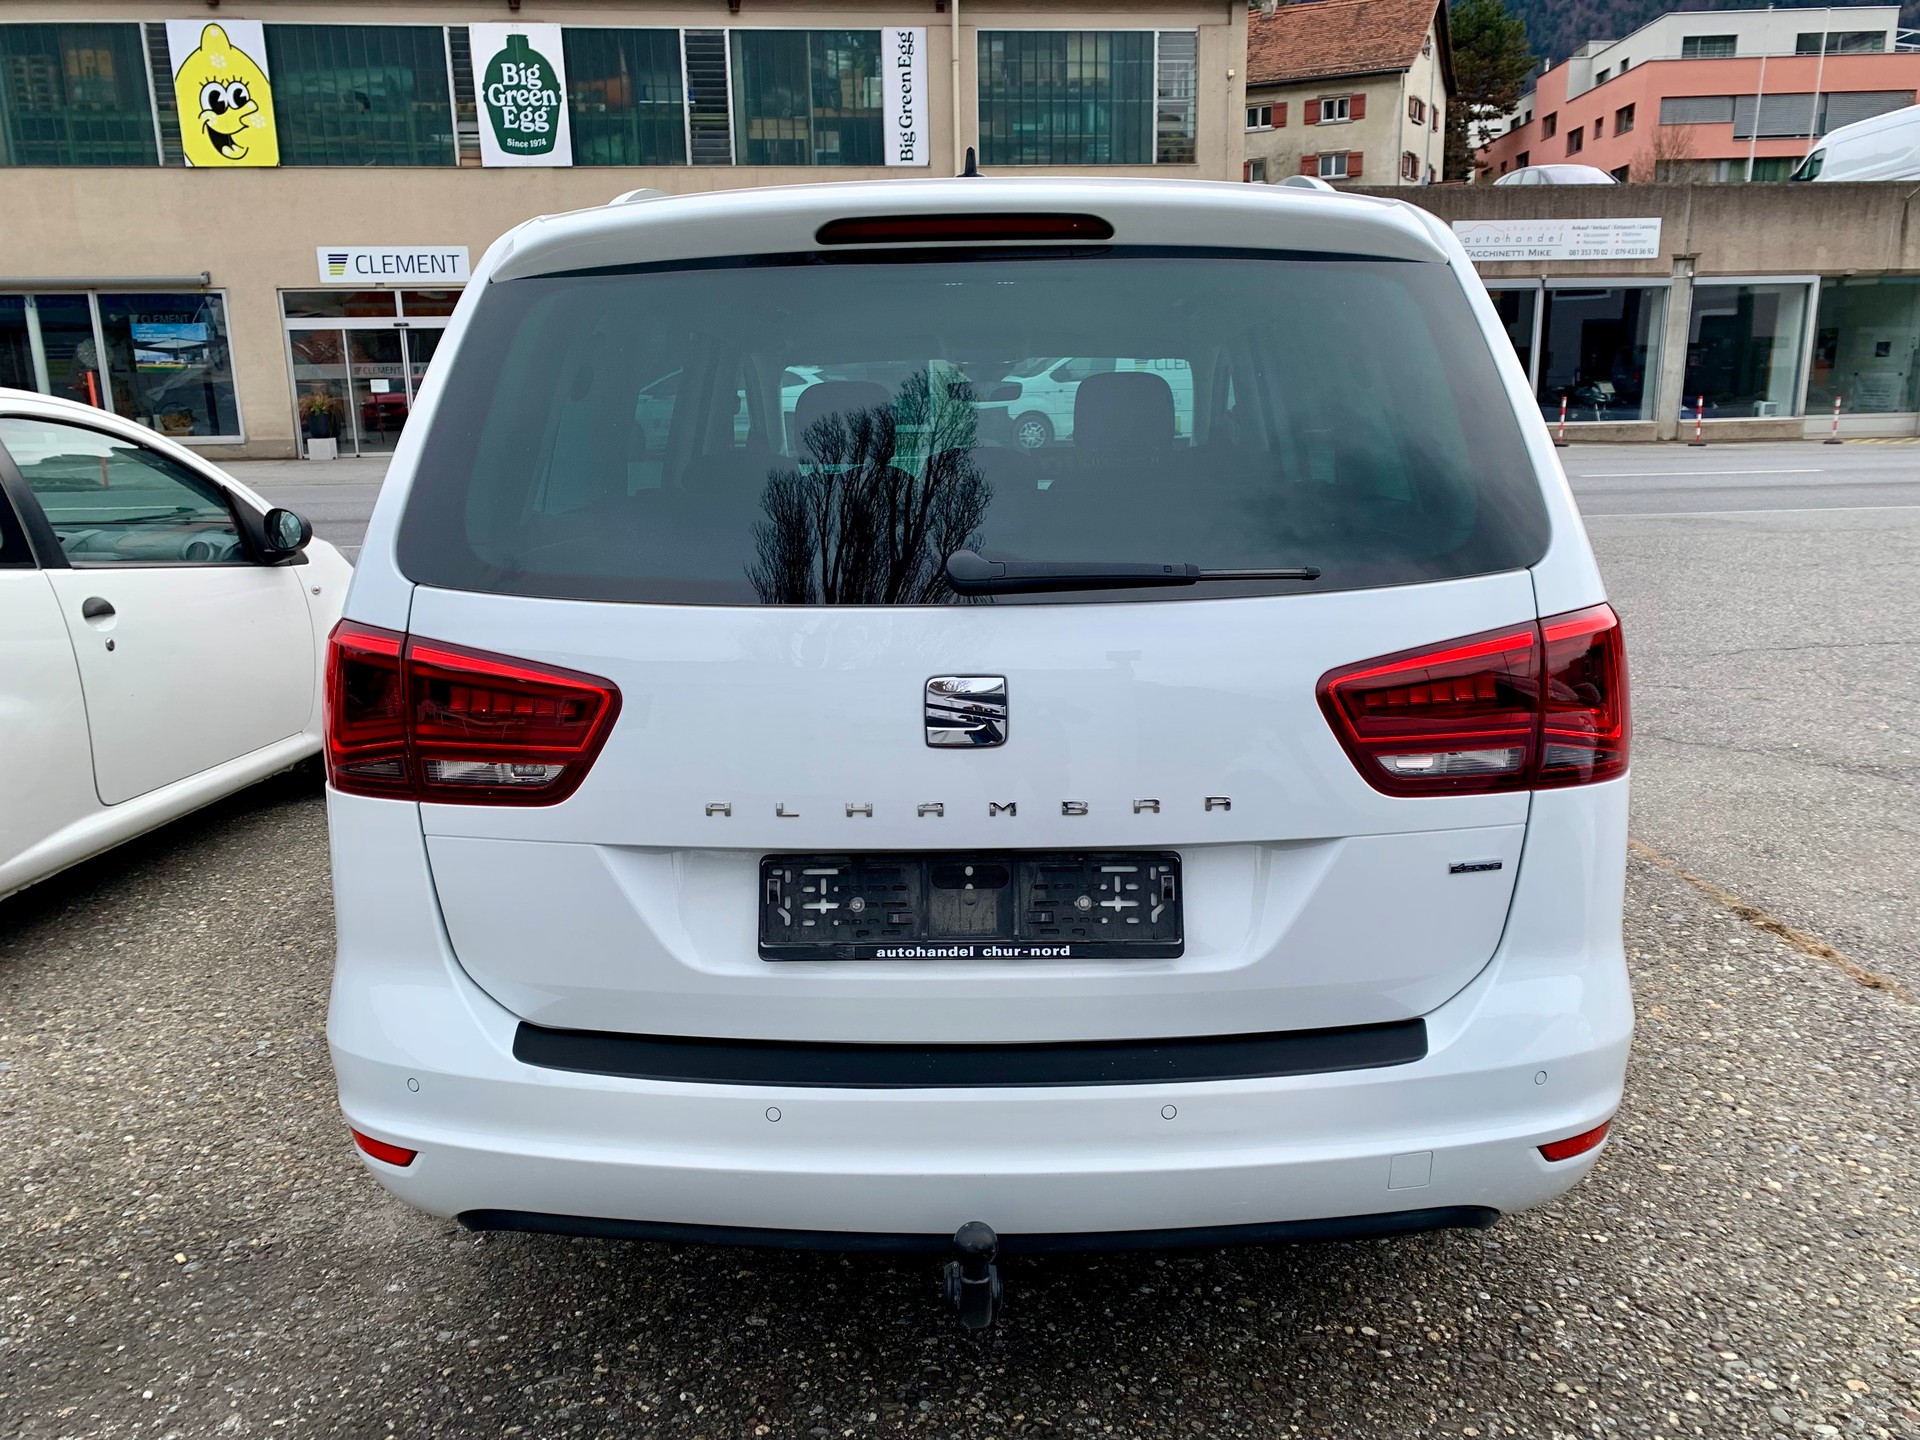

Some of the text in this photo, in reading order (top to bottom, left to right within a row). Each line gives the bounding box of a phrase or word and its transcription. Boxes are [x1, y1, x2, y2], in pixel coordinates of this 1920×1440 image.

[500, 62, 542, 89] Big
[488, 83, 558, 107] Green
[897, 31, 916, 162] Big Green Egg
[501, 106, 550, 132] Egg
[507, 138, 547, 148] Since 1974
[1464, 233, 1563, 244] autohandel
[1465, 249, 1524, 258] FACCHINETTI
[355, 254, 460, 274] CLEMENT
[363, 366, 402, 375] CLEMENT
[705, 795, 1232, 818] ALHAMBRA
[876, 945, 1072, 958] autohandel chur-nord
